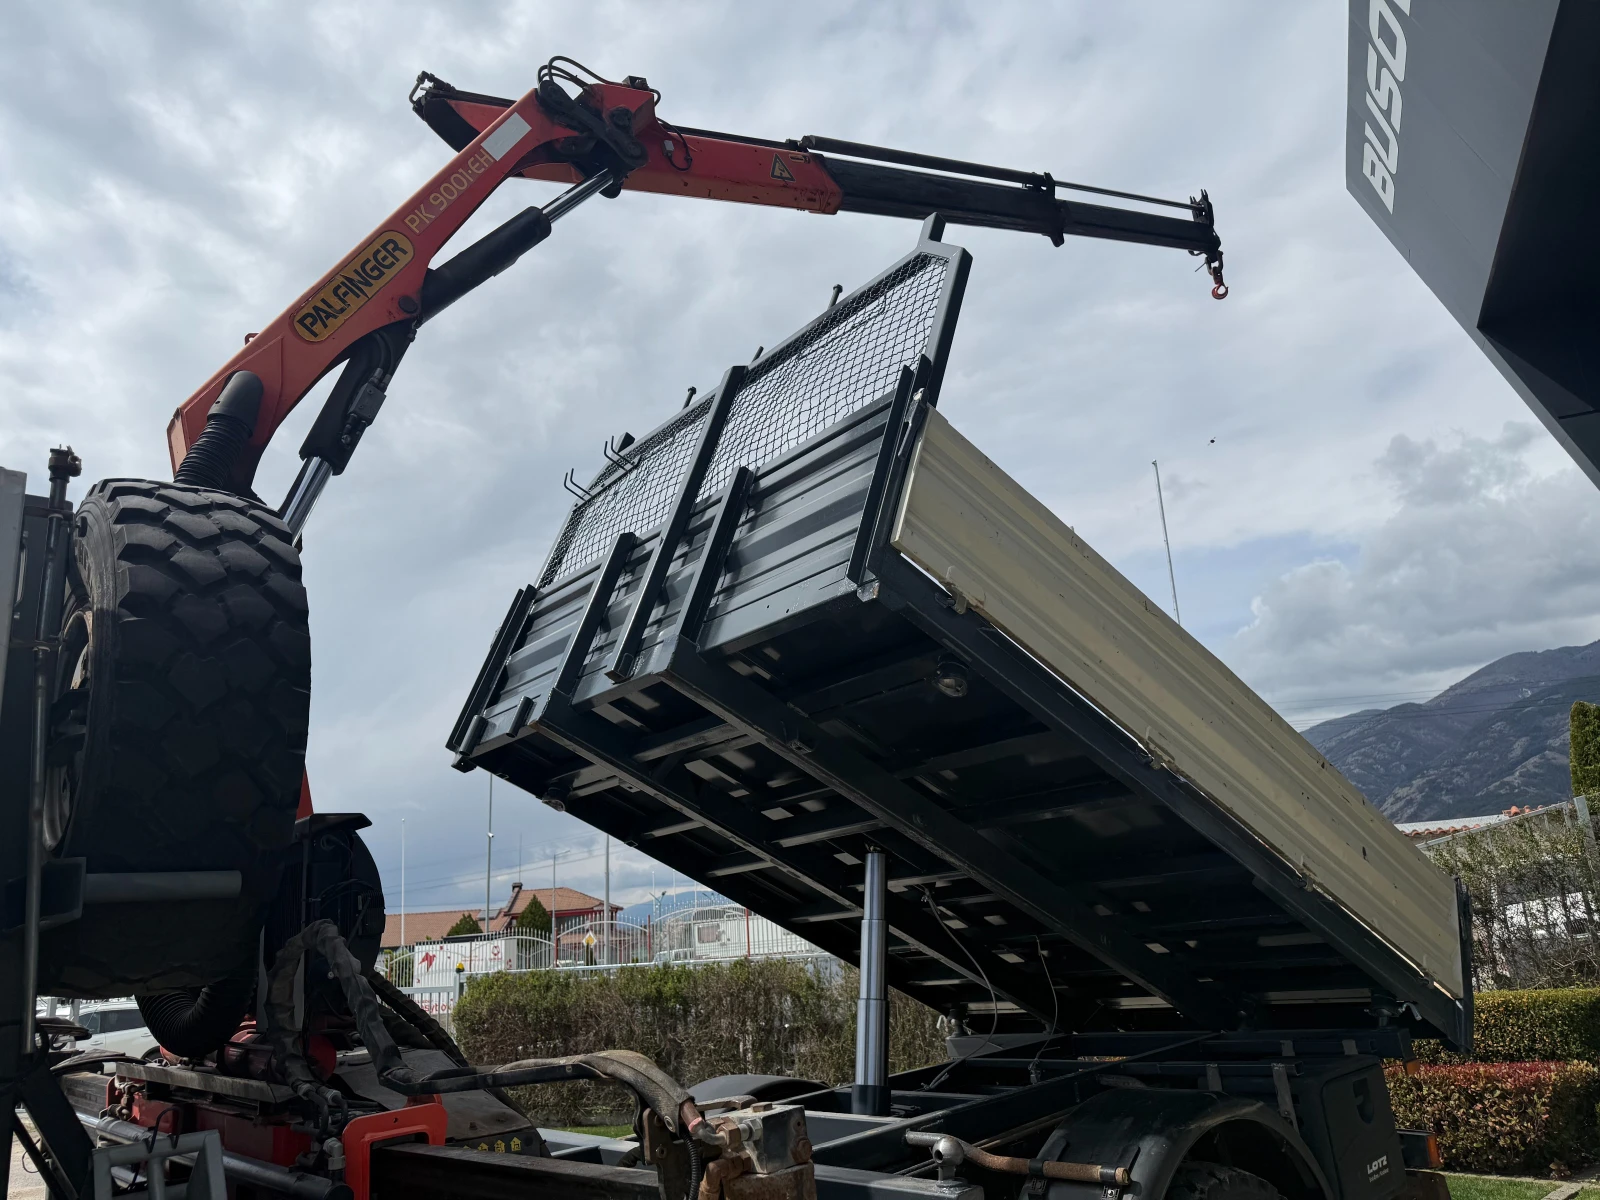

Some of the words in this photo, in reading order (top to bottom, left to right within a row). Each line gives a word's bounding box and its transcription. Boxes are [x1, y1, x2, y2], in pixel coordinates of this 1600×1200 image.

[1362, 0, 1411, 215] BUSO
[404, 203, 436, 233] PK
[296, 238, 409, 338] PALFINGER
[1367, 1155, 1388, 1175] LOTZ
